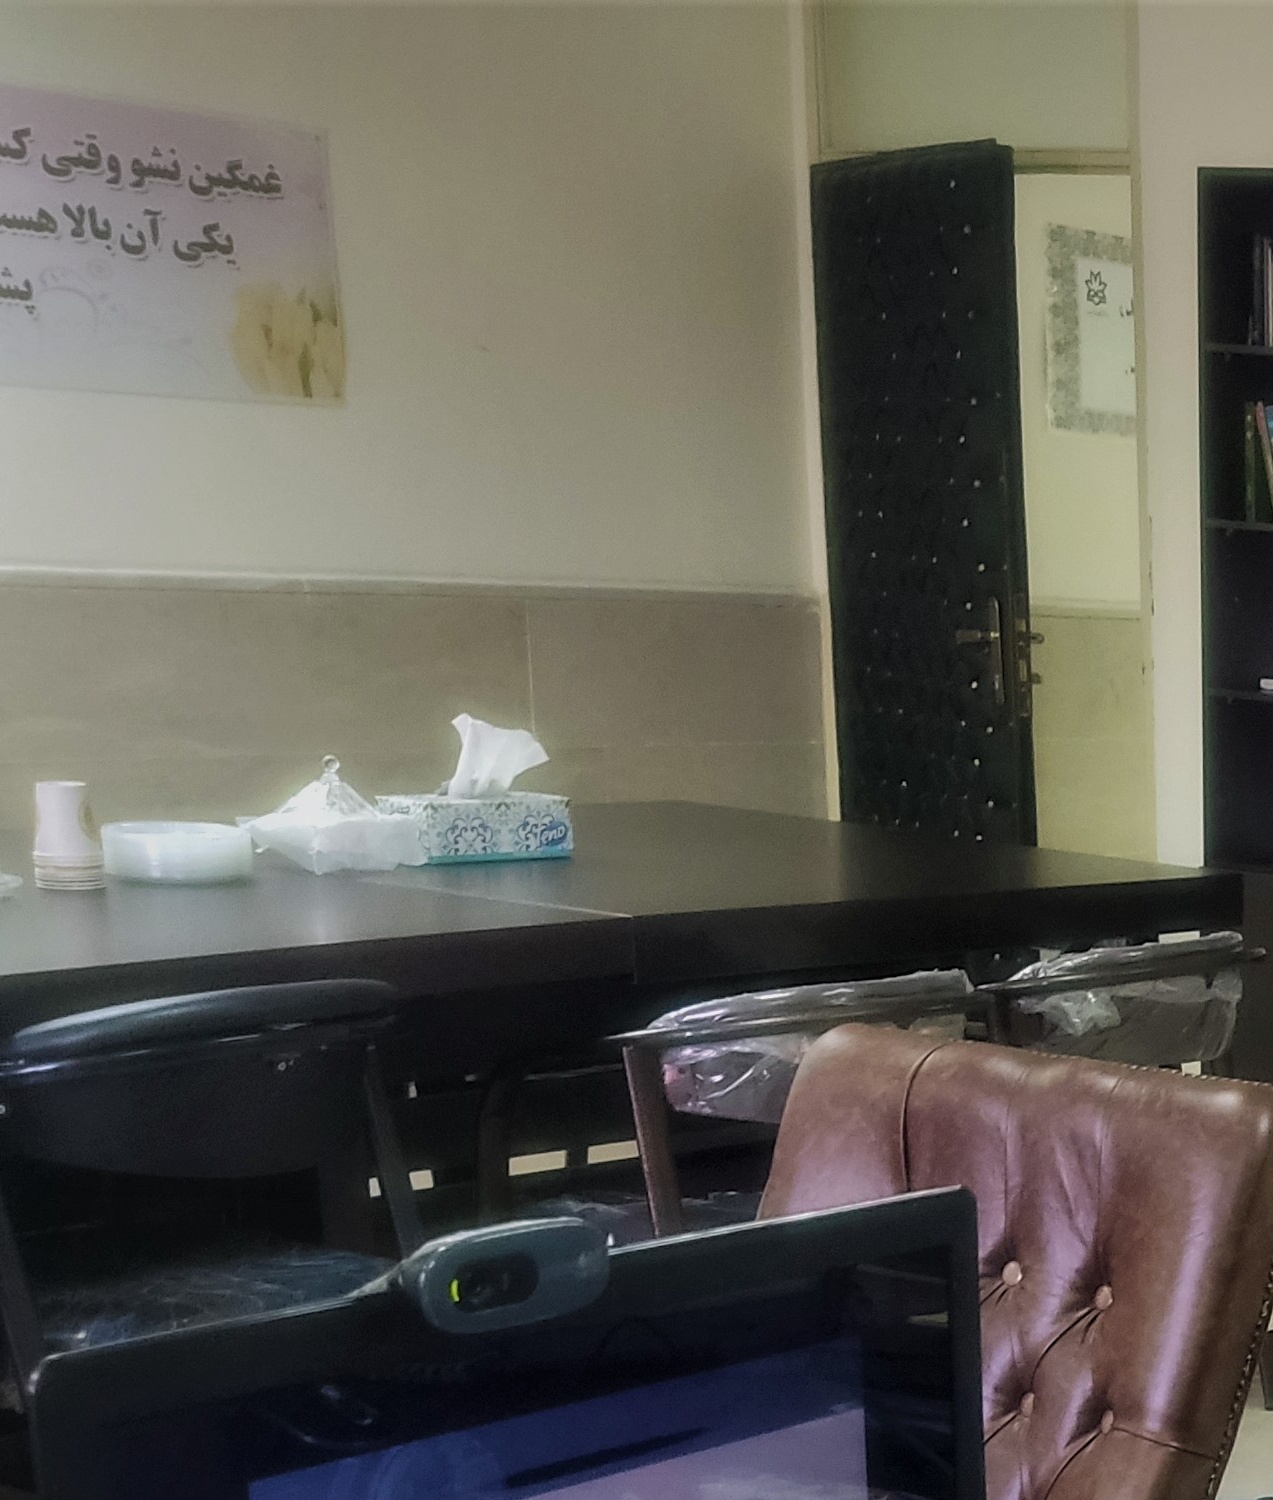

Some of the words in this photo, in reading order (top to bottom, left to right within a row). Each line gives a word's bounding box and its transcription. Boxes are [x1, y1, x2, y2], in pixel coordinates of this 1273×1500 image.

[0, 127, 32, 161] ک
[42, 133, 122, 185] وقتی
[130, 146, 182, 188] نشو
[189, 159, 283, 198] غمگین
[0, 207, 58, 234] هس
[62, 202, 113, 251] بالا
[120, 208, 163, 255] آن
[173, 222, 237, 266] یکی
